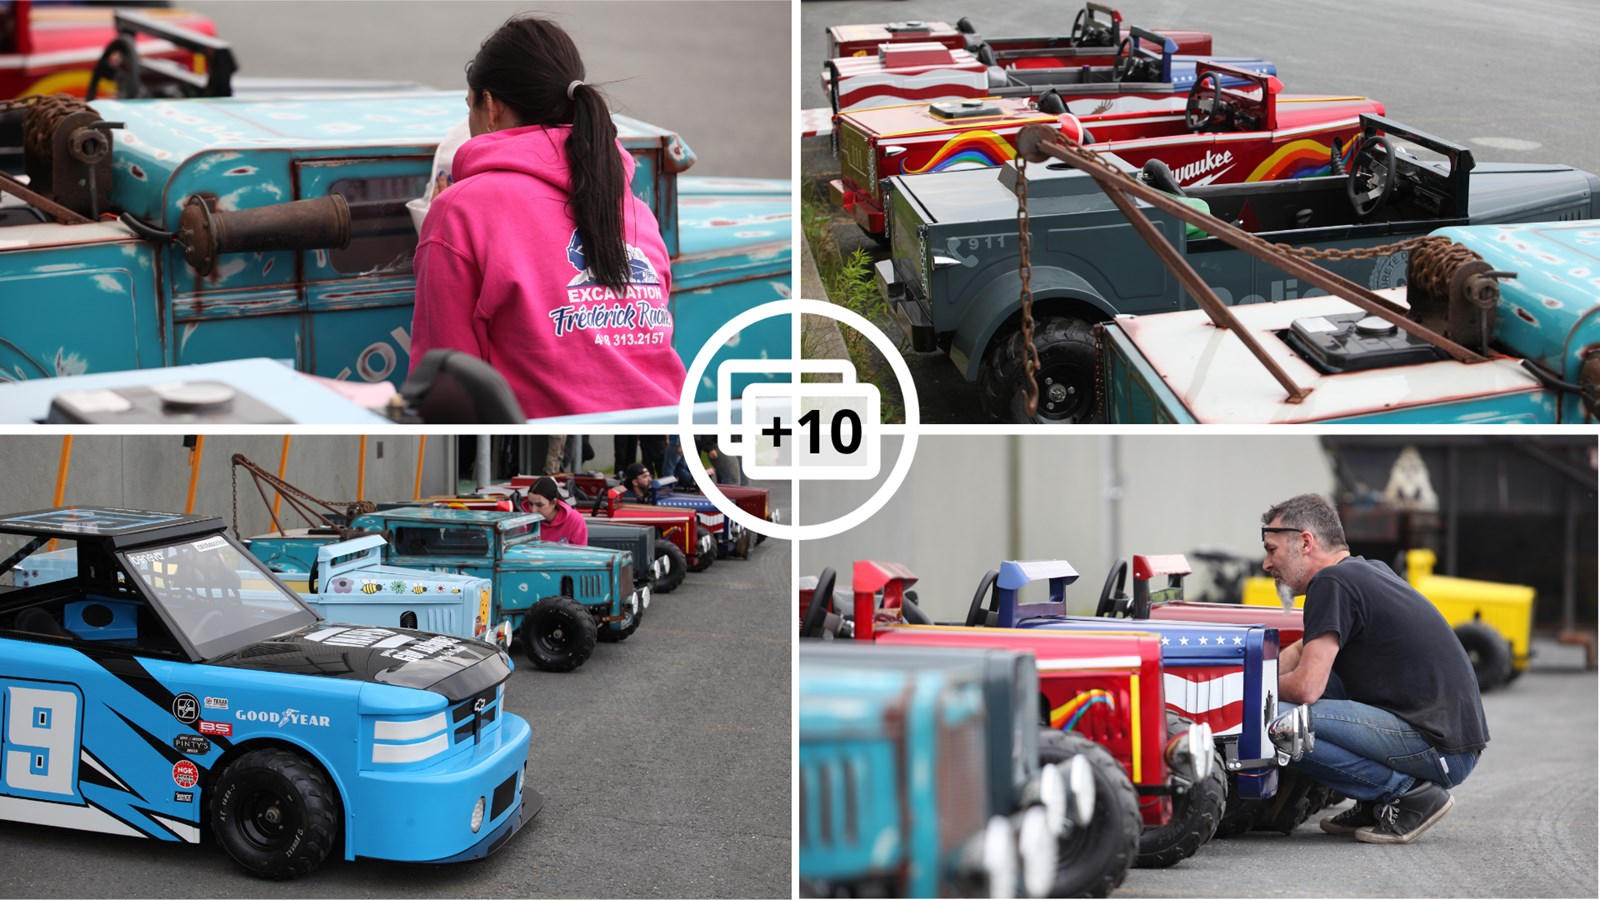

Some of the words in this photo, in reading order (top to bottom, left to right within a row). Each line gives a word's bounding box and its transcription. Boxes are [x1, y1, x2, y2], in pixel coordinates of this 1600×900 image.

[1170, 150, 1233, 184] waukee
[968, 235, 1004, 250] 911
[1382, 254, 1399, 288] URETÉ
[568, 286, 662, 303] EXCAVATION
[549, 302, 637, 337] Frédérick
[595, 333, 611, 346] 48
[613, 332, 664, 346] 313.2157
[200, 722, 230, 733] BS
[6, 686, 78, 796] 9
[175, 739, 208, 749] PINTY'S
